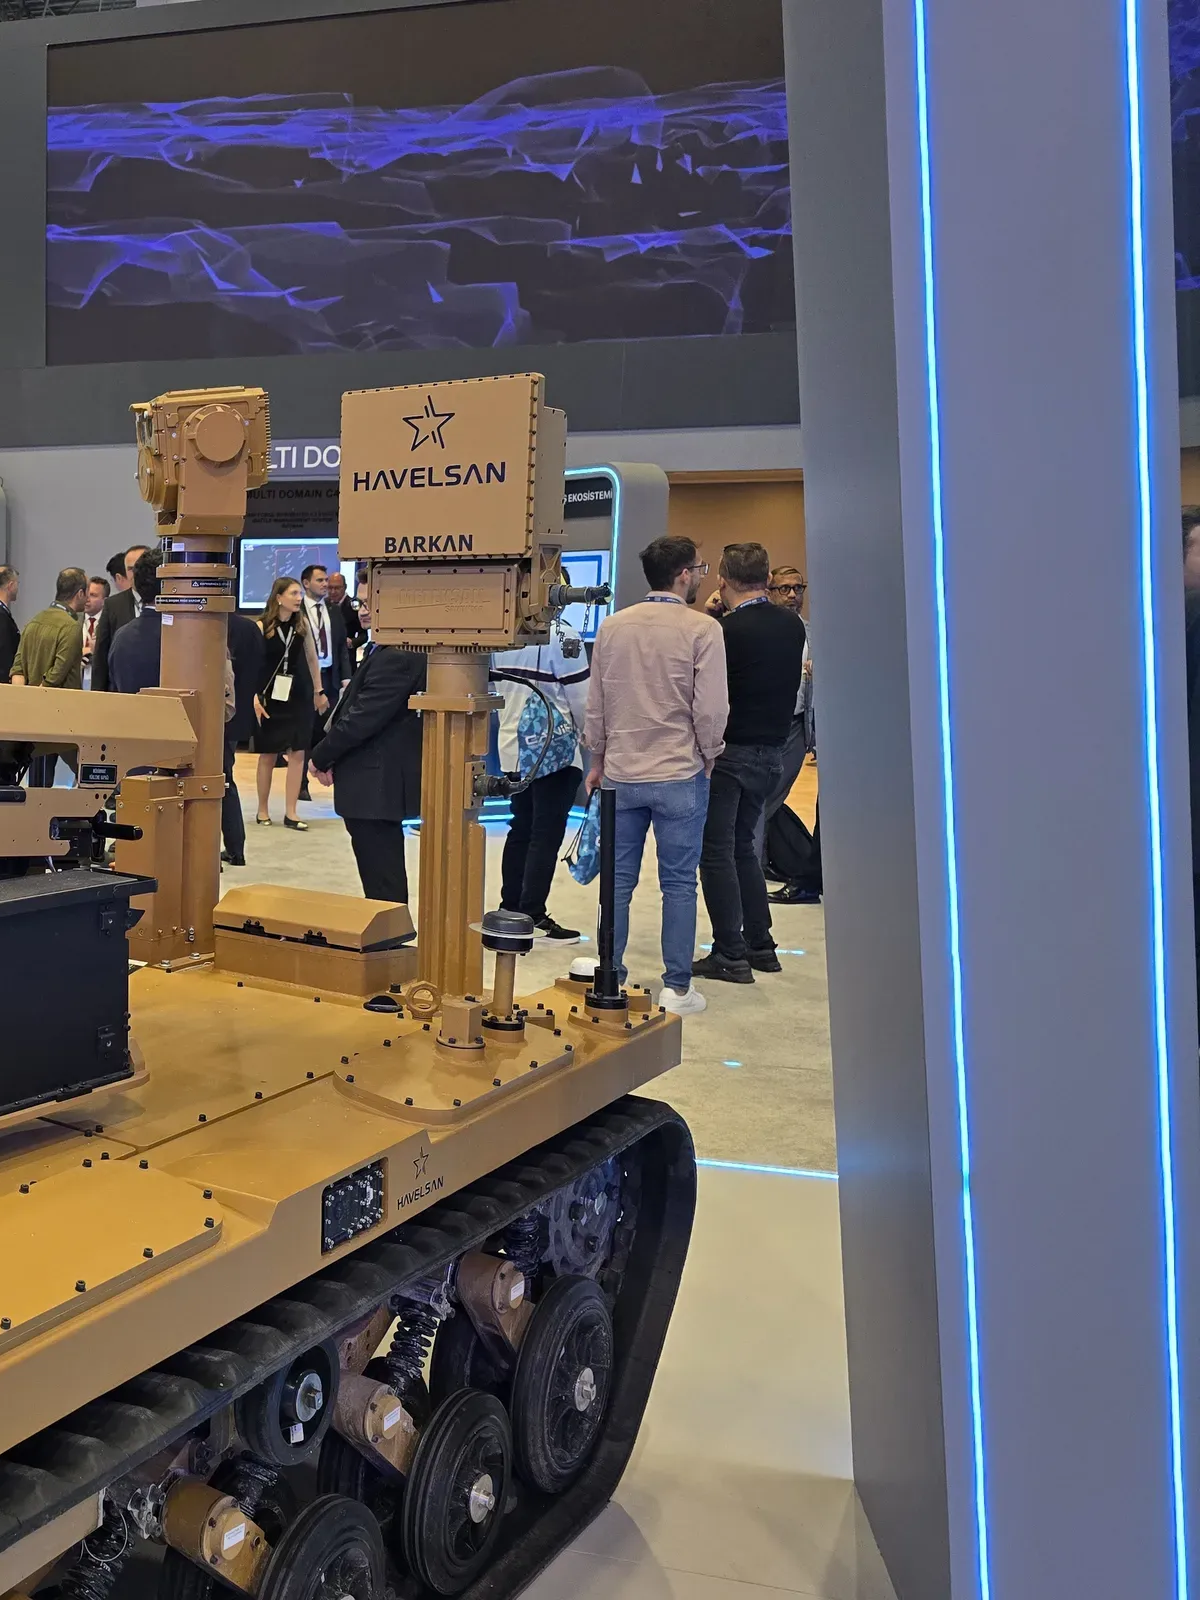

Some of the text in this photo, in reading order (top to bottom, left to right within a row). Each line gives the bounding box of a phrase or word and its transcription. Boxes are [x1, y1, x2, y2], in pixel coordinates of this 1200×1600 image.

[353, 461, 506, 492] HAVELSAN
[384, 534, 473, 554] BARKAN
[397, 1175, 444, 1210] HAVELSAN
